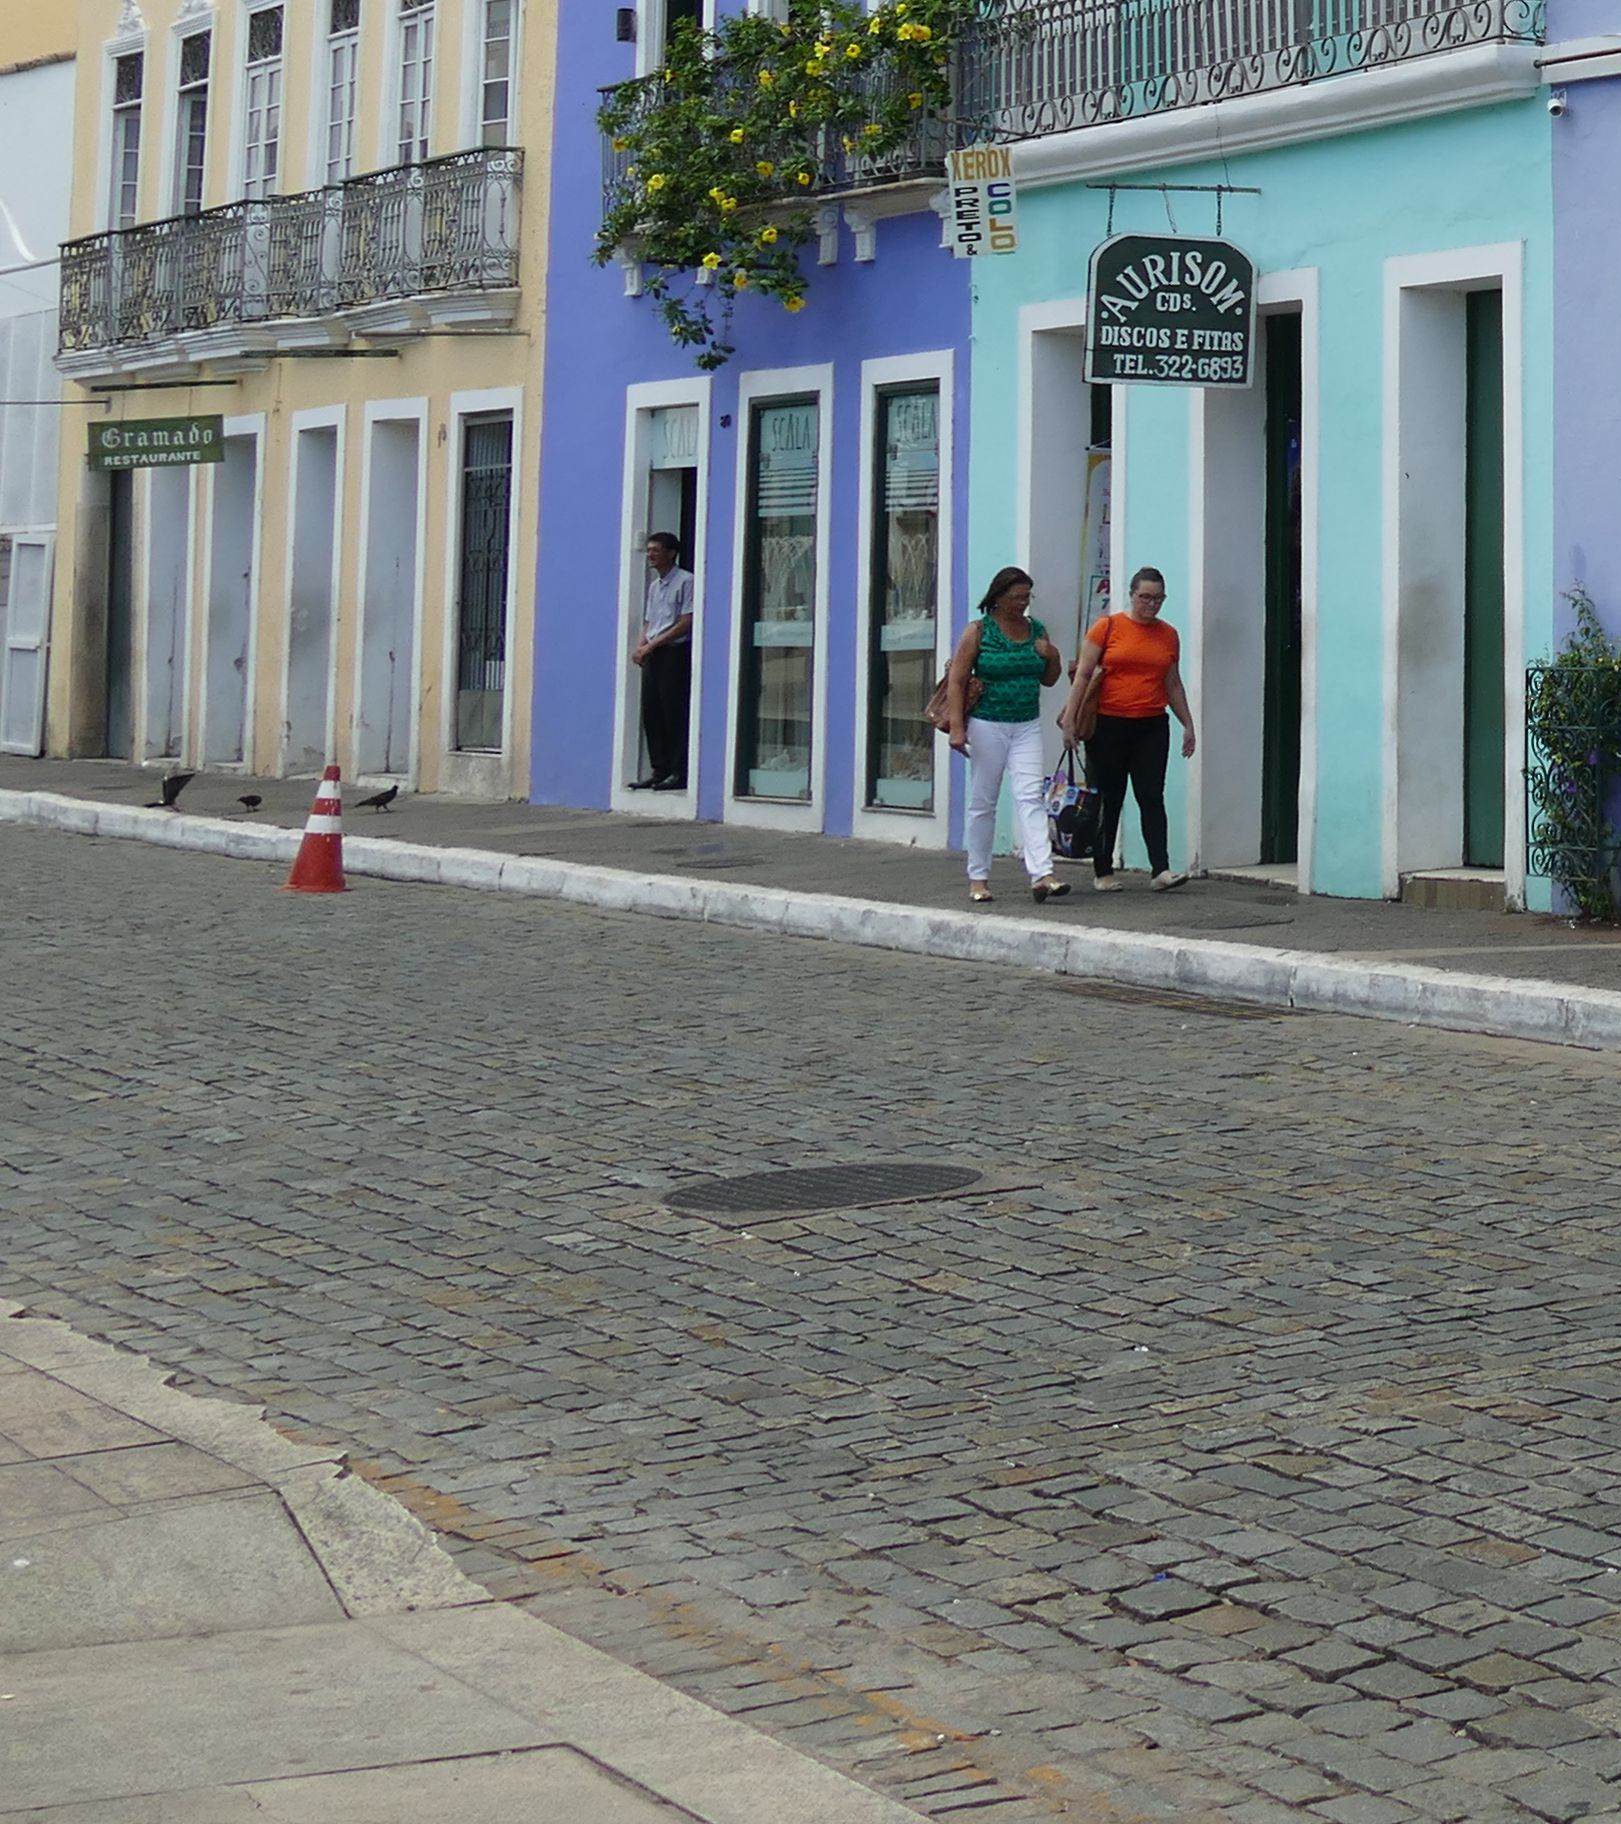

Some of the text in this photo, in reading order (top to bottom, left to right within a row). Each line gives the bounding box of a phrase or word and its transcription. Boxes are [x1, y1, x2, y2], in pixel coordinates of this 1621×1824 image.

[951, 147, 1011, 181] XEROX
[954, 185, 982, 243] PRETO
[987, 182, 1016, 256] COLO
[1100, 251, 1245, 323] AURISOM
[1101, 326, 1244, 352] DISCOS E FITAS
[102, 422, 213, 448] Gramado
[772, 413, 811, 452] SCALA
[104, 451, 201, 466] RESTAURANTE
